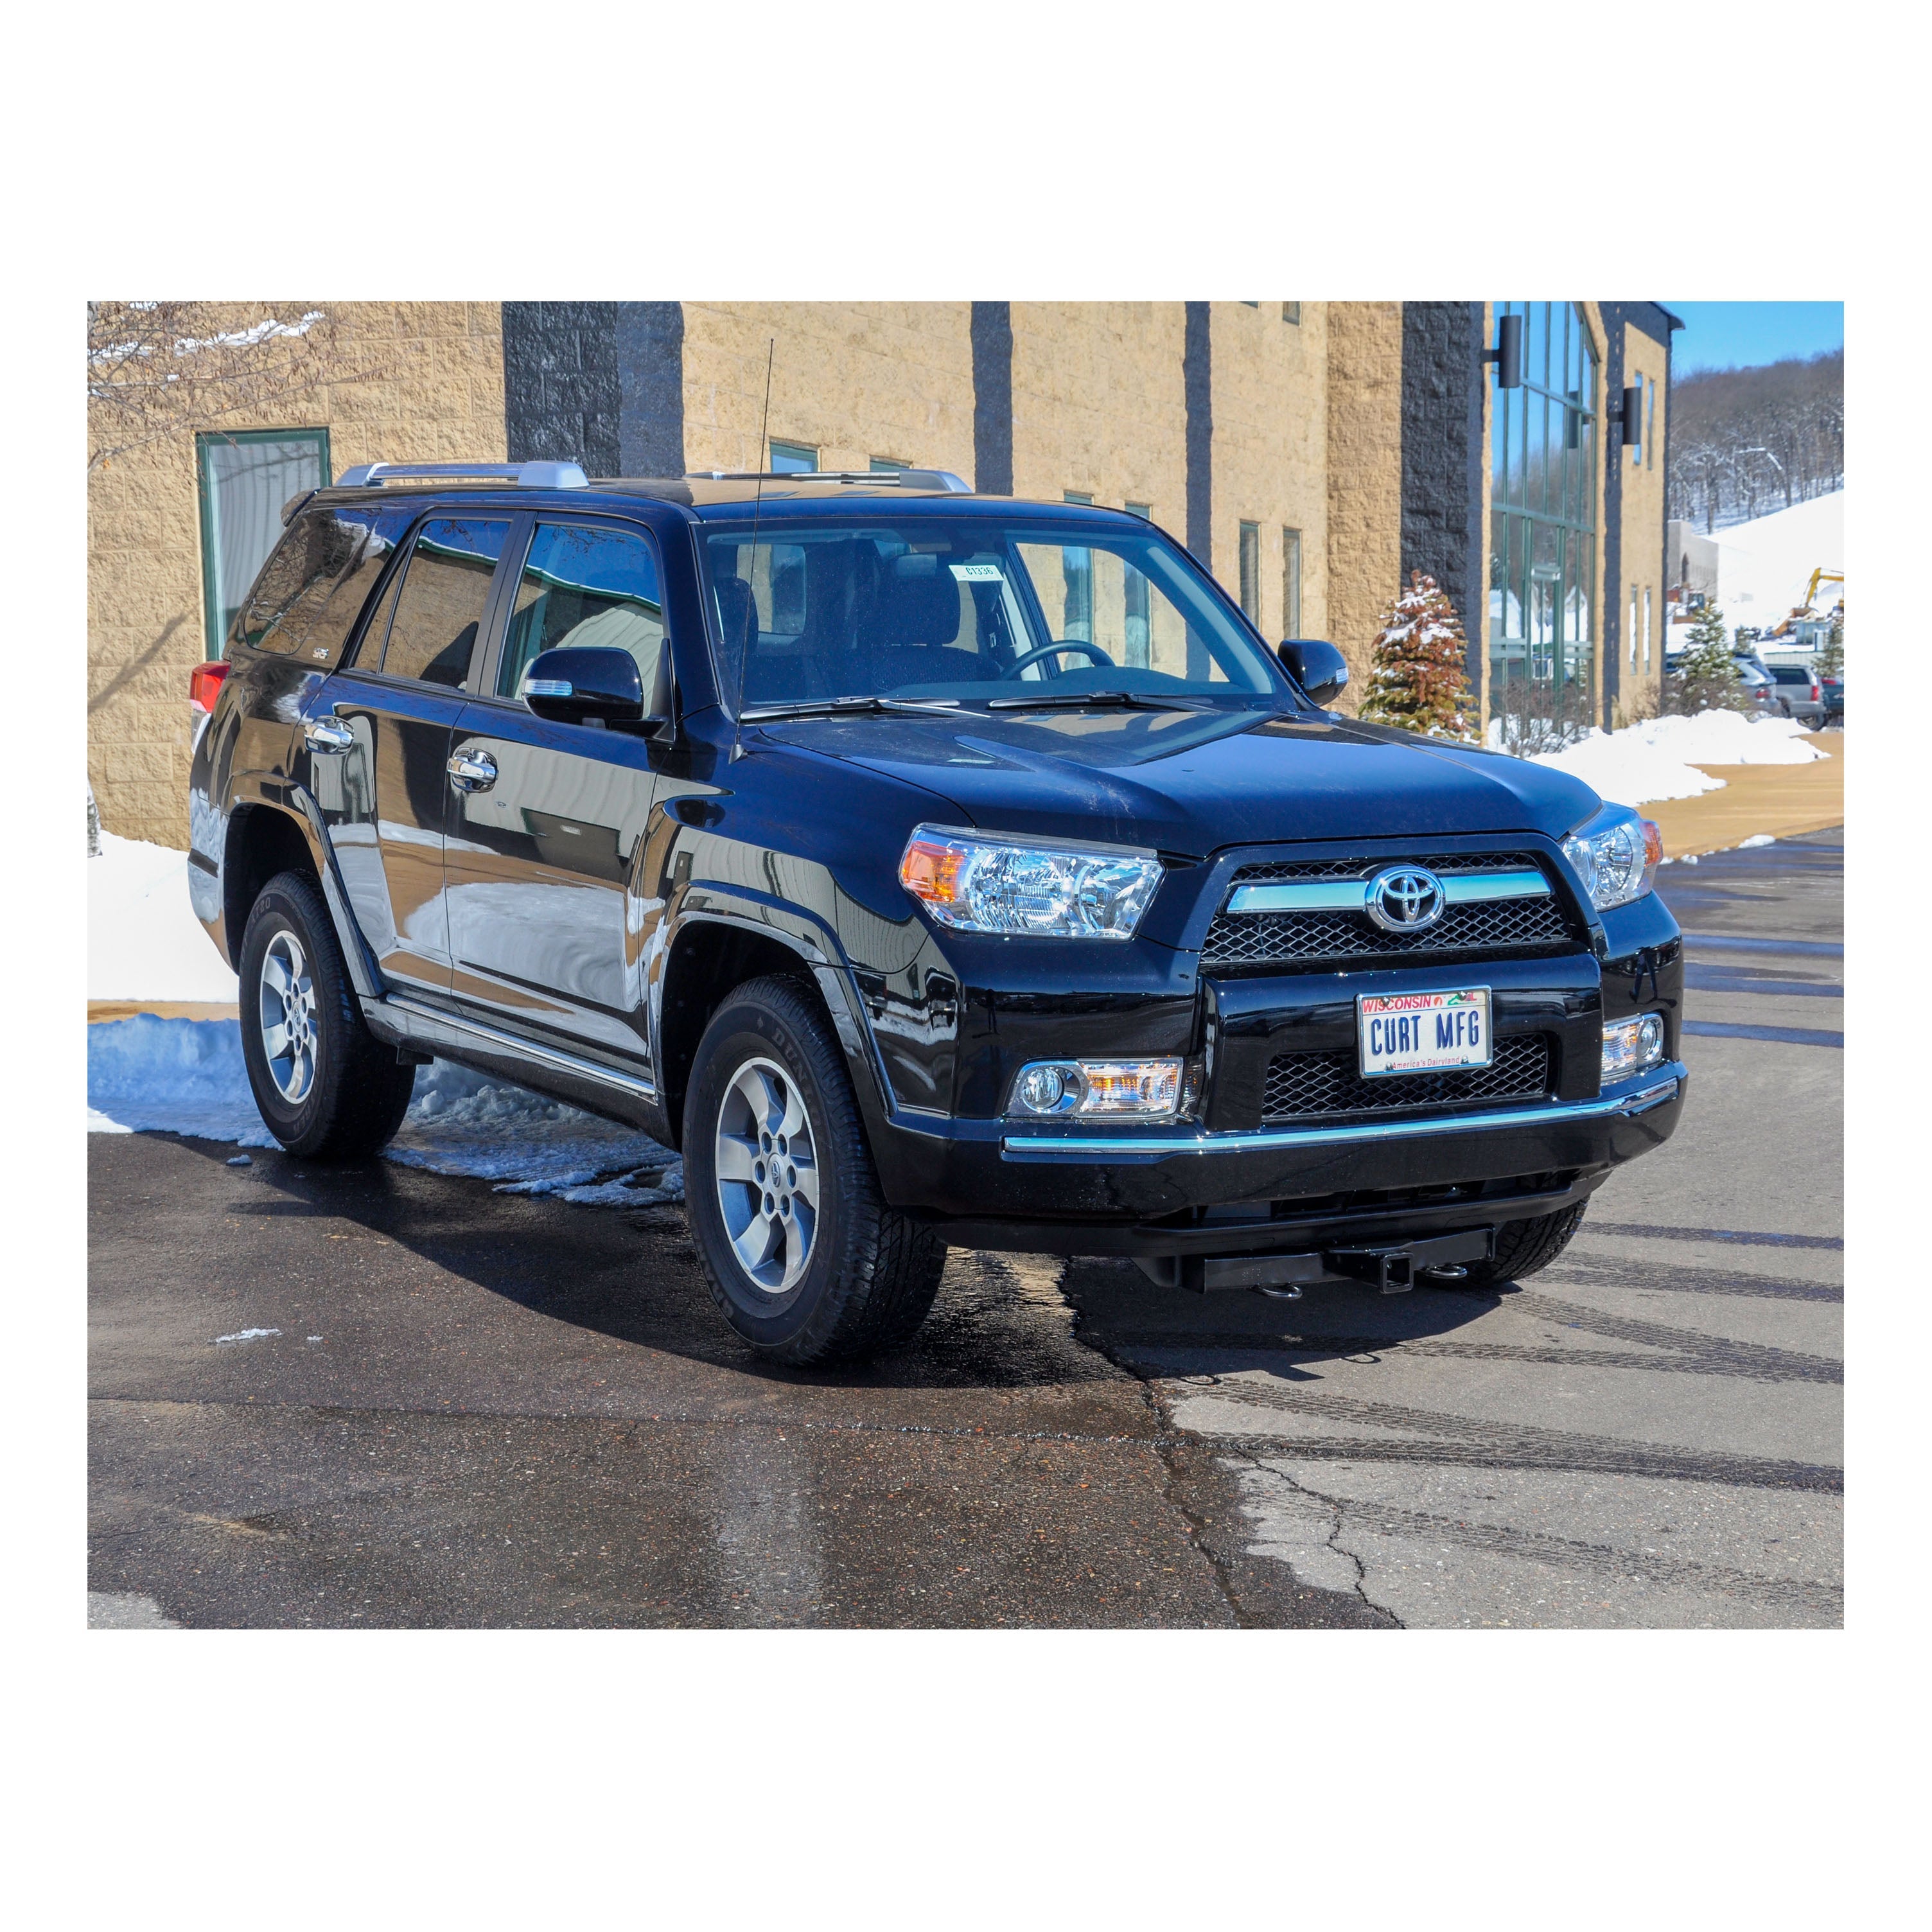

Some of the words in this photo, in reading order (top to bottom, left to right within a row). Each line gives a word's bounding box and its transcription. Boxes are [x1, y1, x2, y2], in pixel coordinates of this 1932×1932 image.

[965, 566, 994, 575] C1336
[1362, 995, 1432, 1014] WISCONSIN
[1371, 1015, 1421, 1056] CURT
[1436, 1010, 1479, 1050] MFG
[1392, 1059, 1426, 1070] America's
[1427, 1055, 1461, 1066] Dairyland
